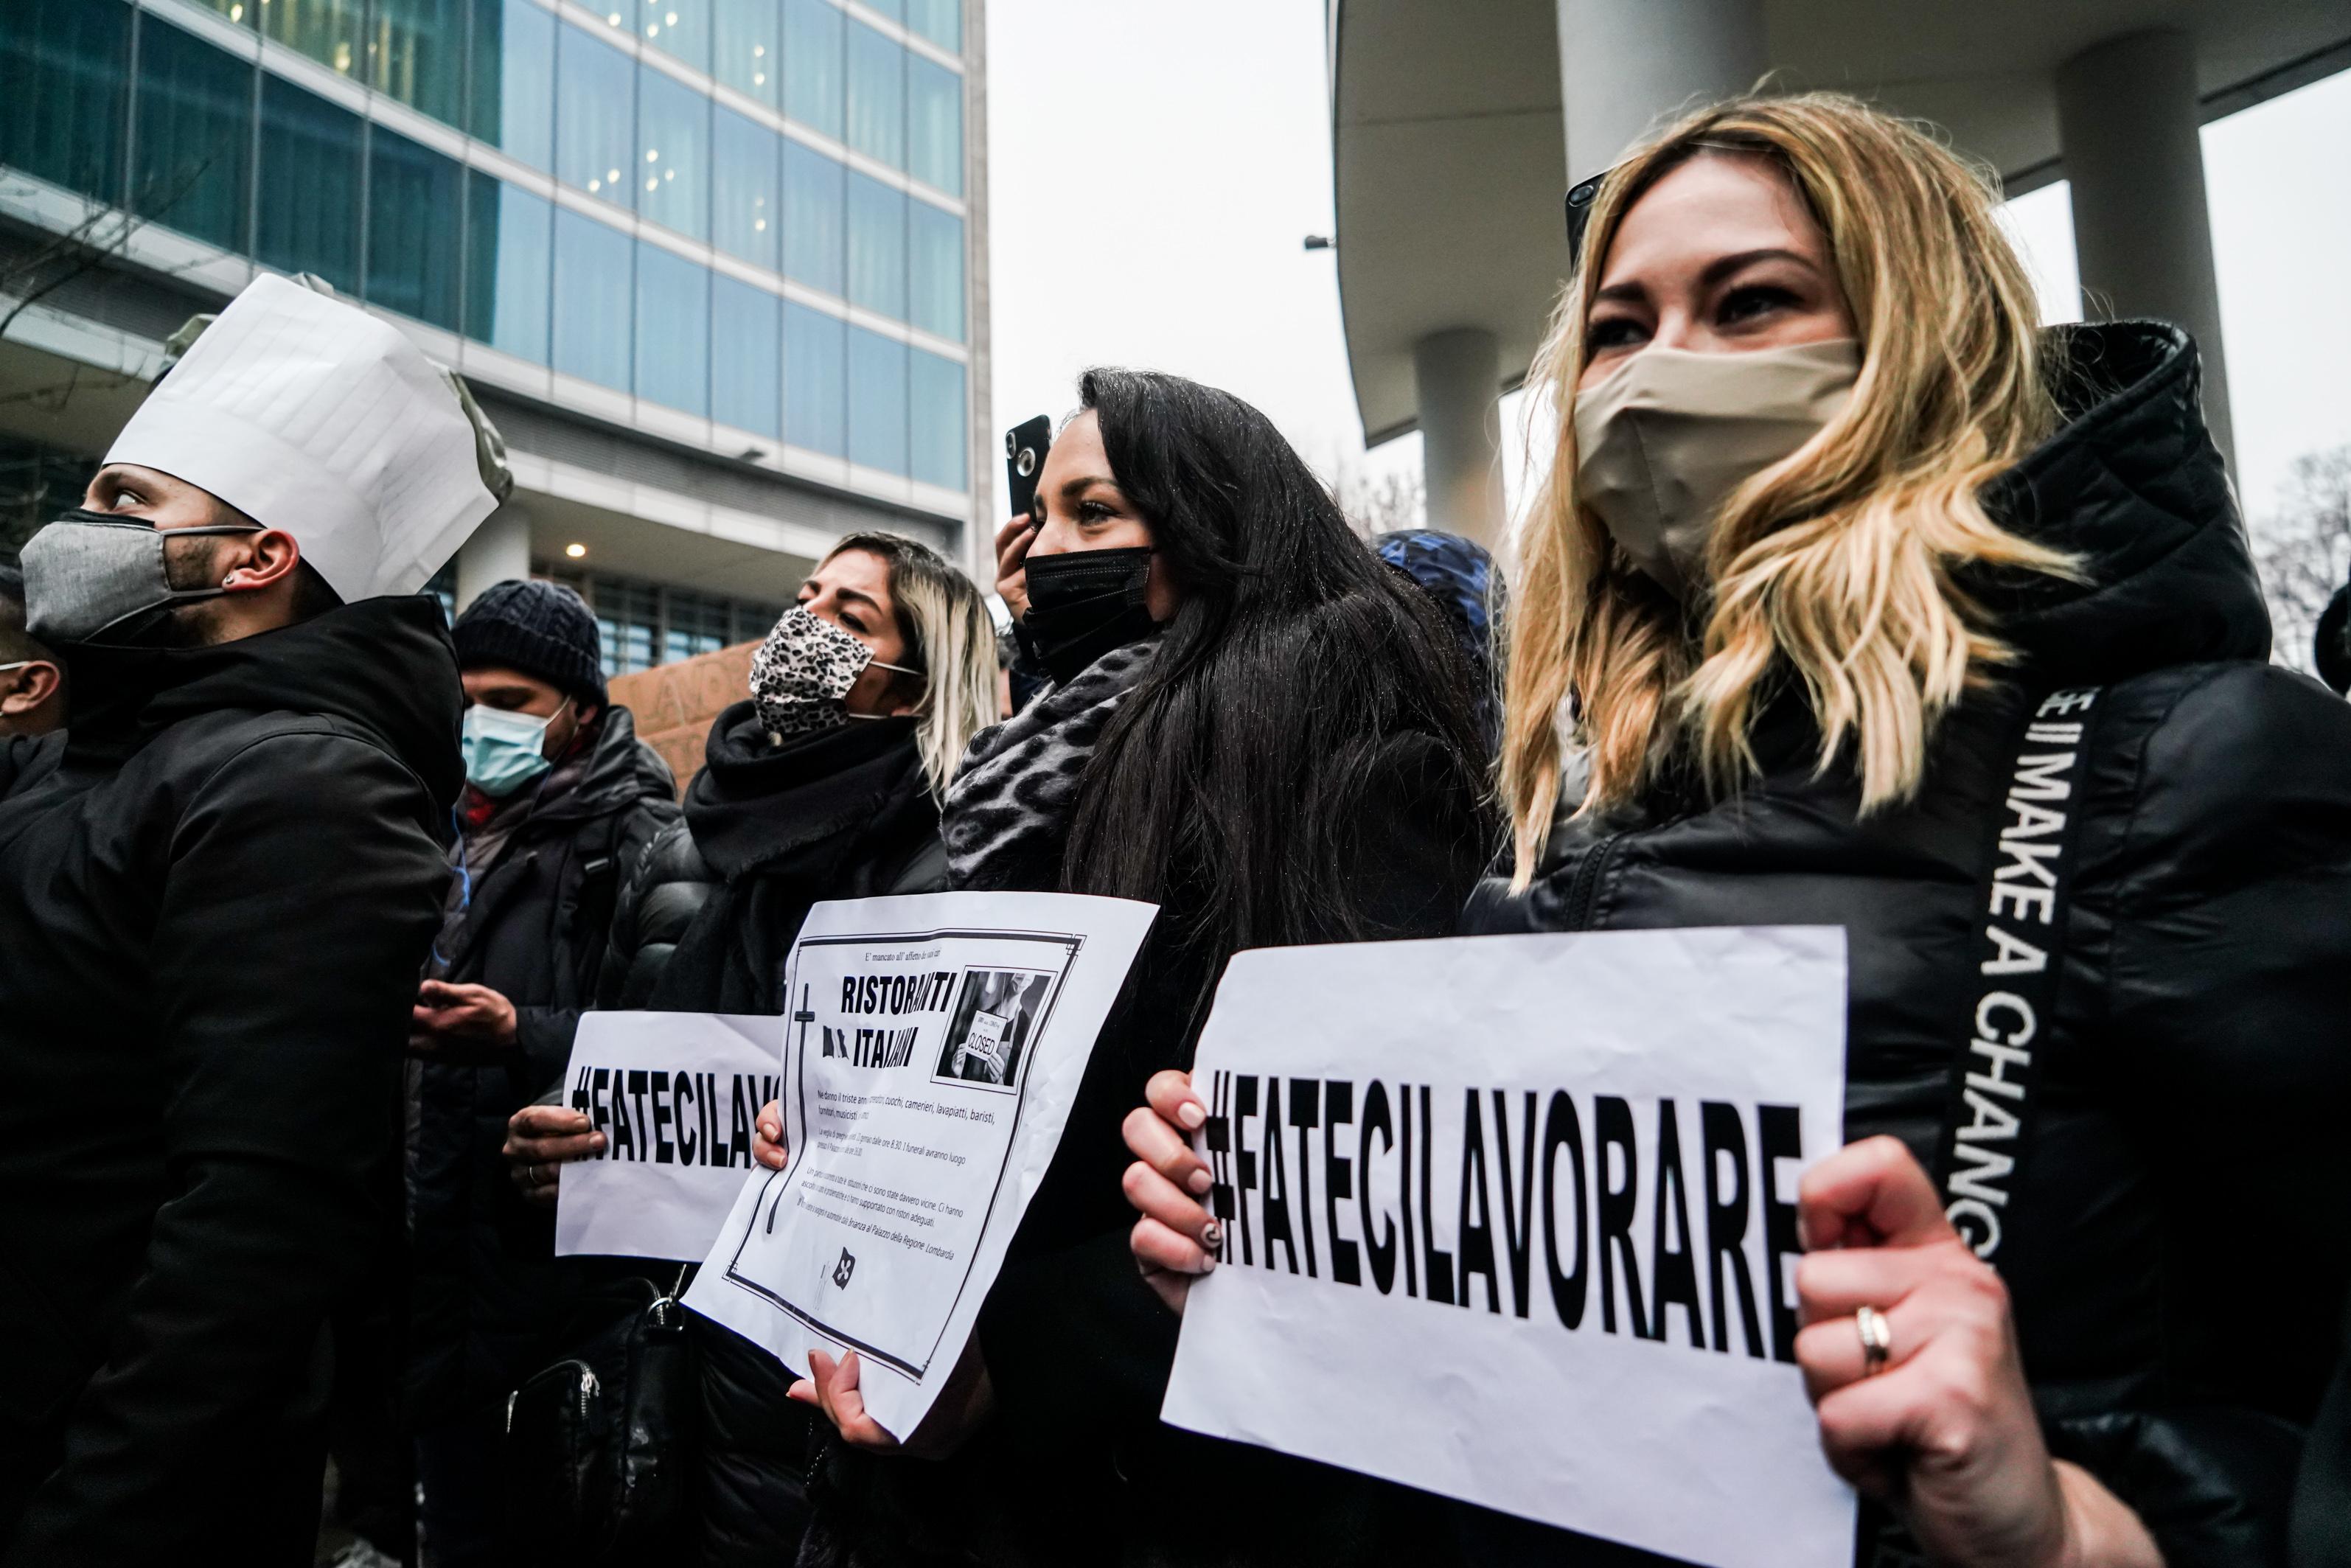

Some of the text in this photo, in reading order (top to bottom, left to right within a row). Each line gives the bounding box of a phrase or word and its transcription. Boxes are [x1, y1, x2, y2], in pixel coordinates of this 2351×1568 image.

[1988, 751, 2077, 925] MAKE
[872, 953, 895, 961] mancato
[1980, 926, 2048, 976] A
[968, 1032, 995, 1055] CLOSED
[571, 1066, 780, 1169] #FATECILAV
[824, 1091, 837, 1102] danno
[842, 1093, 857, 1104] triste
[885, 1095, 904, 1109] cuochi,
[905, 1099, 935, 1115] camerieri,
[936, 1103, 968, 1121] lavapiatti,
[970, 1108, 995, 1126] baristi,
[836, 1109, 857, 1121] musicisti
[1944, 992, 2037, 1268] CHANG
[882, 1139, 891, 1147] ore
[906, 1143, 925, 1156] funerali
[925, 1148, 948, 1160] avranno
[949, 1152, 966, 1166] luogo
[859, 1199, 886, 1213] supportato
[886, 1206, 895, 1216] con
[896, 1207, 910, 1219] ristori
[873, 1186, 886, 1196] sono
[886, 1189, 899, 1200] state
[899, 1192, 919, 1206] davvero
[938, 1202, 944, 1213] Ci
[945, 1204, 964, 1218] hanno
[1206, 1070, 1802, 1365] #FATECILAVORARE
[865, 1223, 872, 1233] al
[871, 1224, 891, 1239] Palazzo
[891, 1230, 903, 1243] della
[902, 1234, 925, 1250] Regione
[925, 1243, 955, 1261] Lombardia
